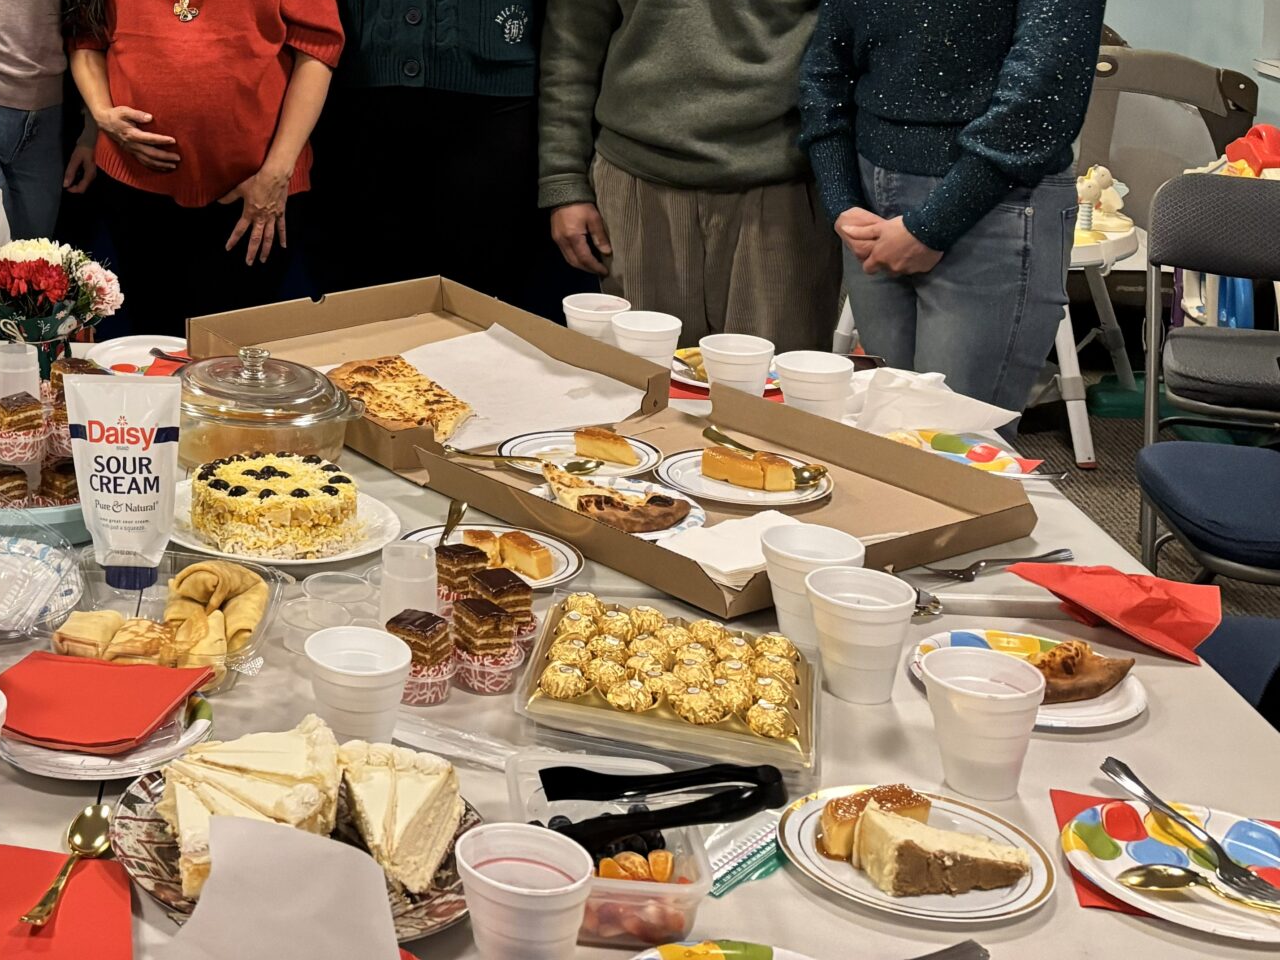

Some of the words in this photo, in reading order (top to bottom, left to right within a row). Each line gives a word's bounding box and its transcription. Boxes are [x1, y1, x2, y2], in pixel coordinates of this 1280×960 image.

[87, 417, 156, 451] Daisy
[93, 455, 153, 475] SOUR
[89, 474, 160, 495] CREAM
[94, 499, 111, 511] Pure
[111, 500, 124, 513] &
[125, 501, 157, 513] Natural
